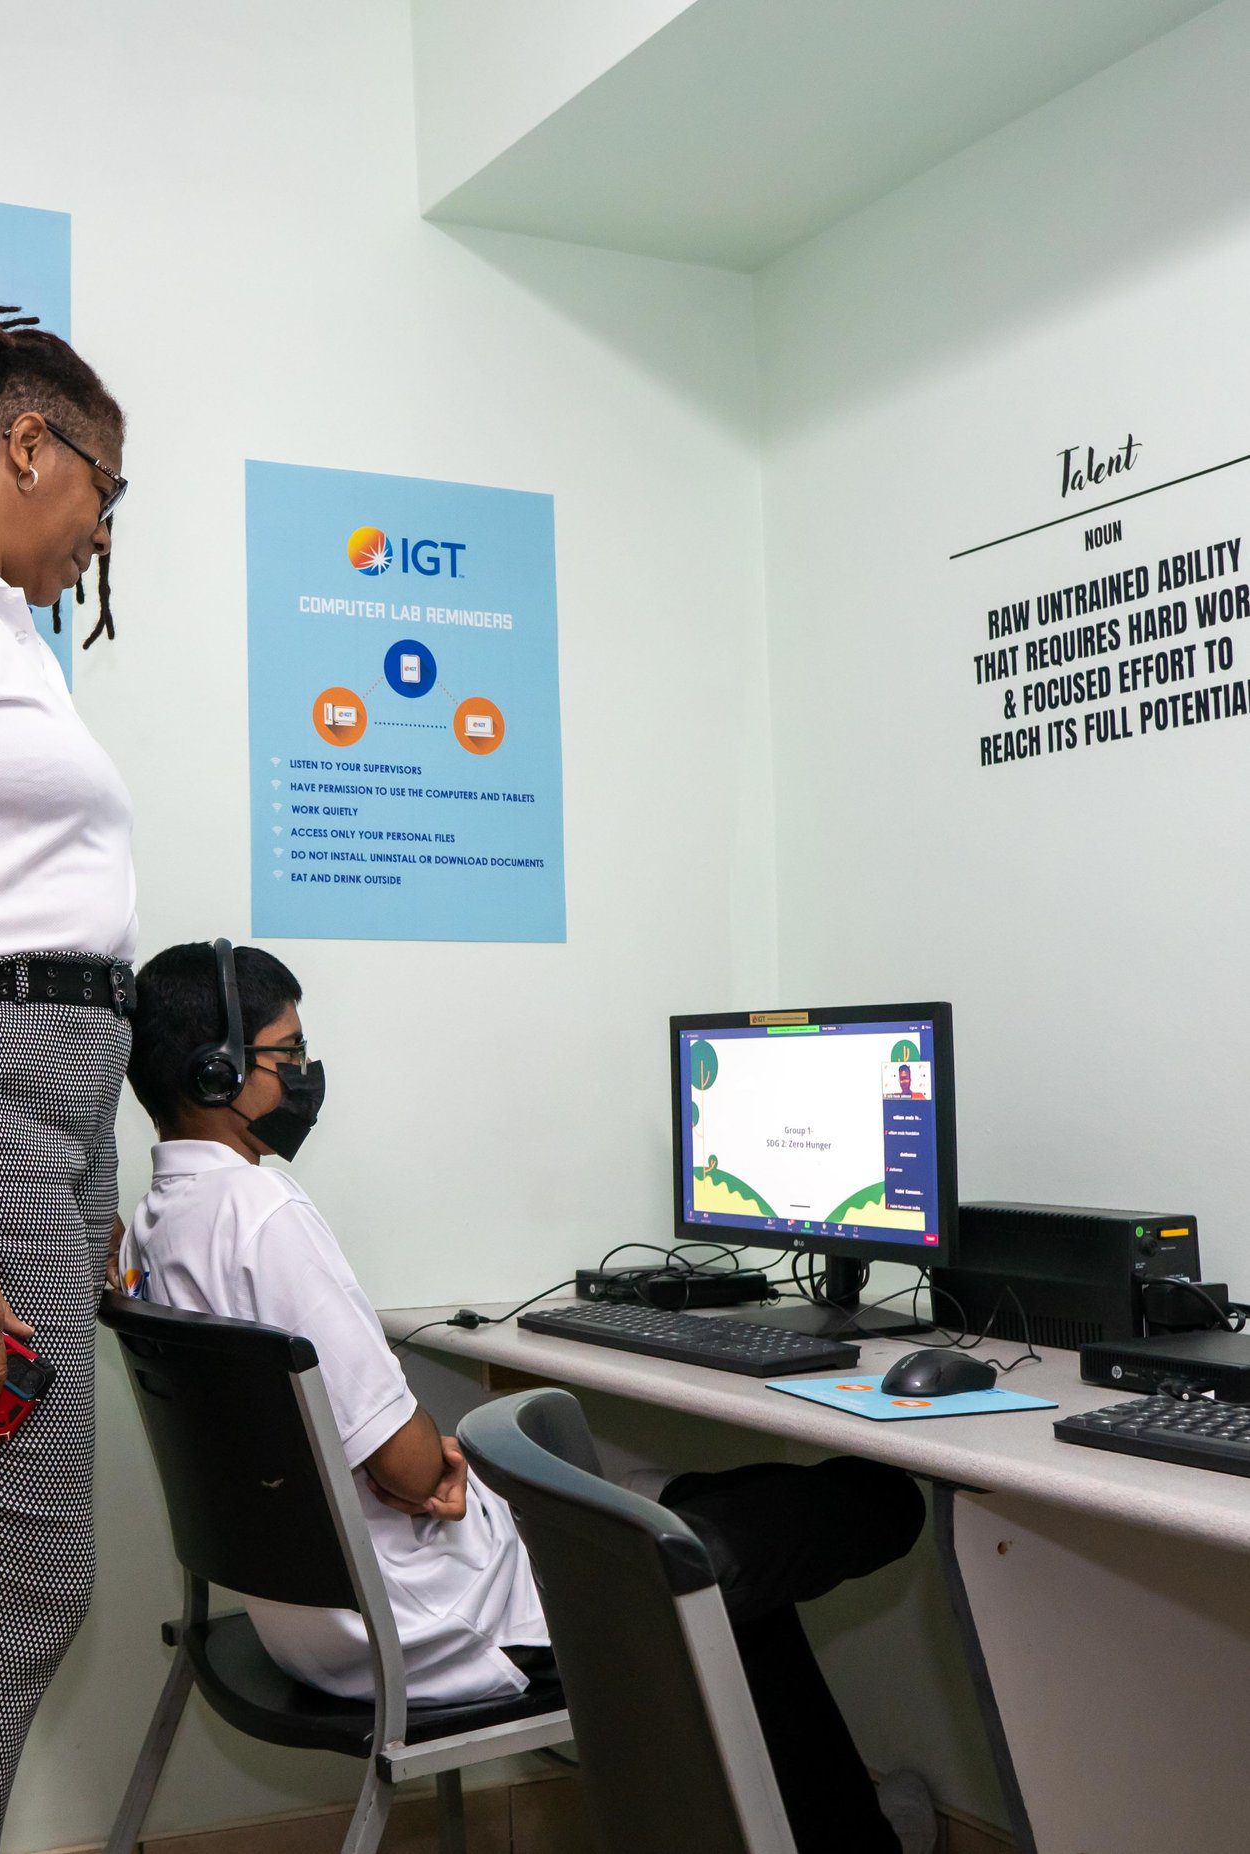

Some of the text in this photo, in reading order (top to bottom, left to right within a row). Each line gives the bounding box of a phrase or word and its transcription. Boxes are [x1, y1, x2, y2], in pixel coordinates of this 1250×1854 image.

[1056, 432, 1143, 498] Talent
[1084, 520, 1123, 552] NOUN
[401, 537, 466, 578] IGT
[987, 536, 1242, 640] RAW UNTRAINED ABILITY
[299, 595, 513, 630] COMPUTER LAB REMINDERS
[973, 645, 1019, 685] THAT
[1025, 618, 1121, 673] REQUIRES
[1128, 600, 1188, 646] HARD
[1003, 636, 1234, 720] & FOCUSED EFFORT TO
[980, 679, 1250, 767] REACH ITS FULL POTENTIA
[290, 759, 422, 775] LISTEN TO YOUR SUPERVISORS
[290, 782, 535, 803] HAVE PERMISSION TO USE THE COMPUTERS AND TABLETS
[291, 805, 358, 817] WORK QUIETLY
[290, 828, 456, 843] ACCESS ONLY YOUR PERSONAL FILES
[291, 850, 545, 868] DO NOT INSTALL, UNINSTALL OR DOWNLOAD DOCUMENTS
[291, 873, 402, 885] EAT AND DRINK OUTSIDE
[784, 1126, 806, 1136] Group
[766, 1139, 832, 1151] SDG 2: Zero Hunger
